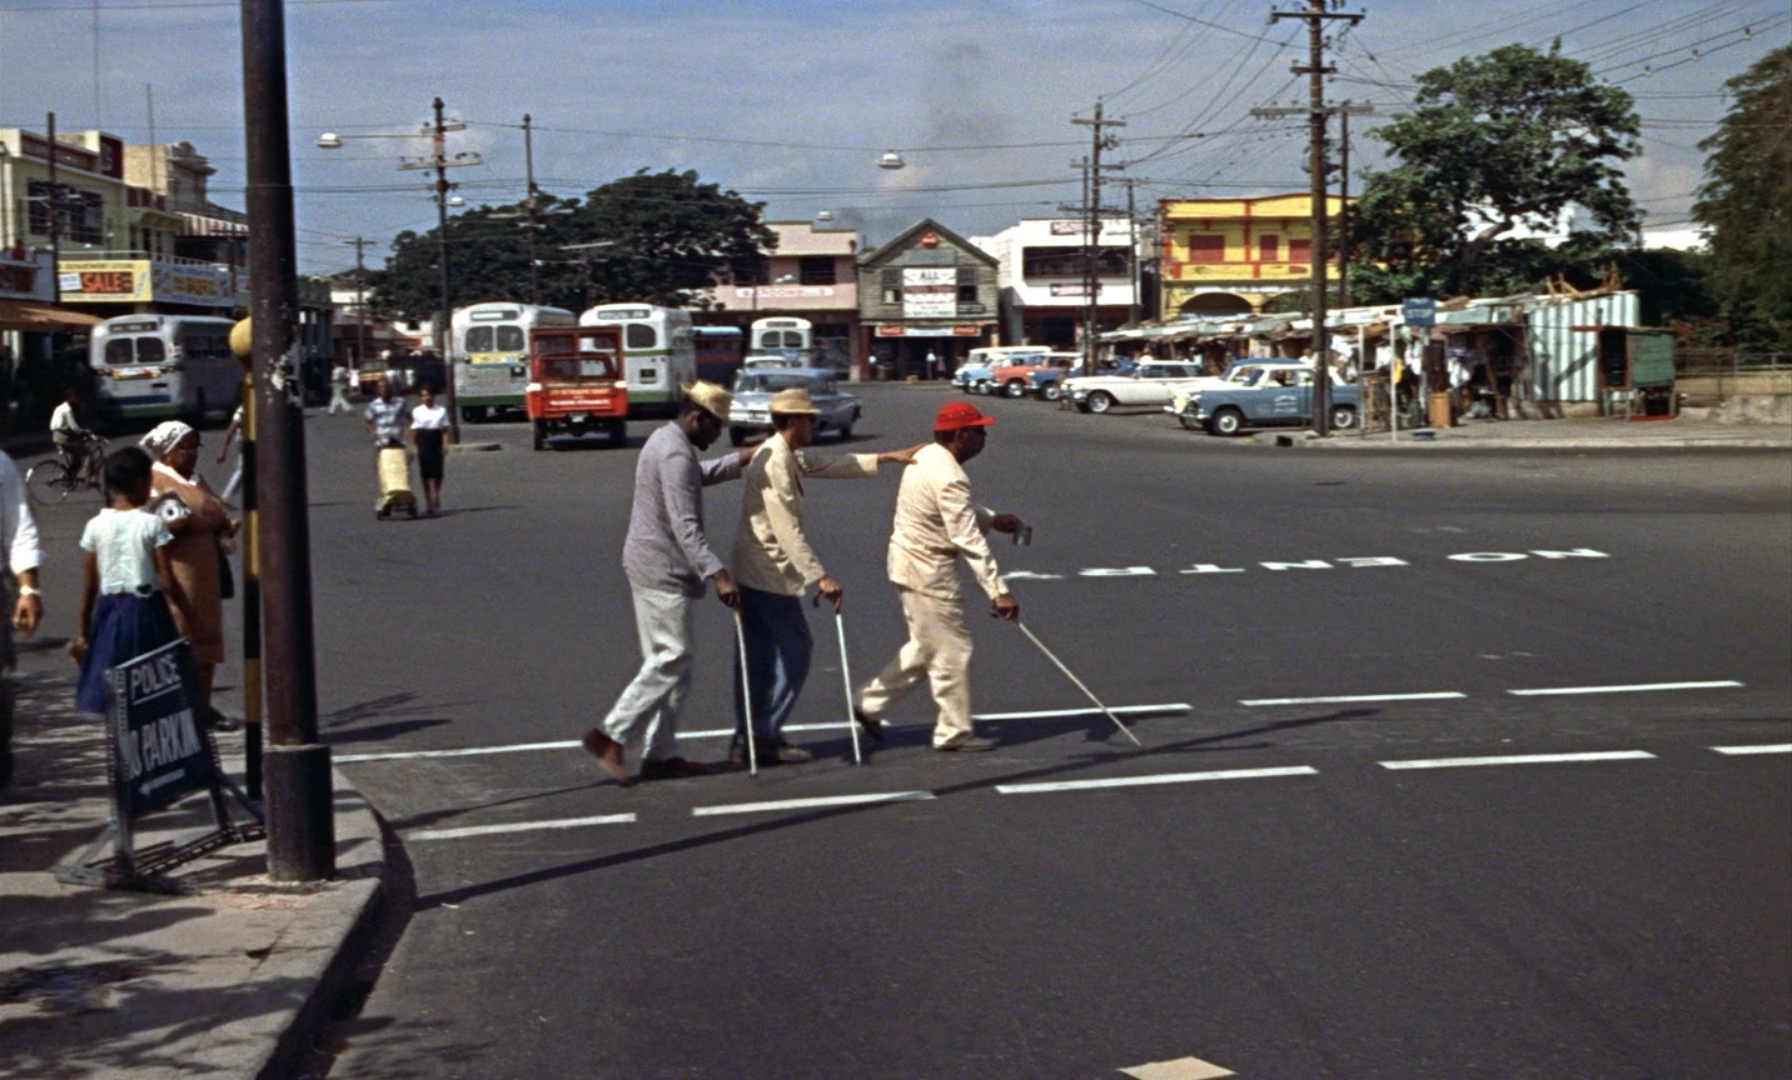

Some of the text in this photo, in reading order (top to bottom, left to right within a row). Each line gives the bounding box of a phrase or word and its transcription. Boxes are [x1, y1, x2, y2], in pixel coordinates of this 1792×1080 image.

[82, 272, 122, 293] SALE
[1446, 548, 1611, 562] NO
[129, 653, 182, 700] POLICE
